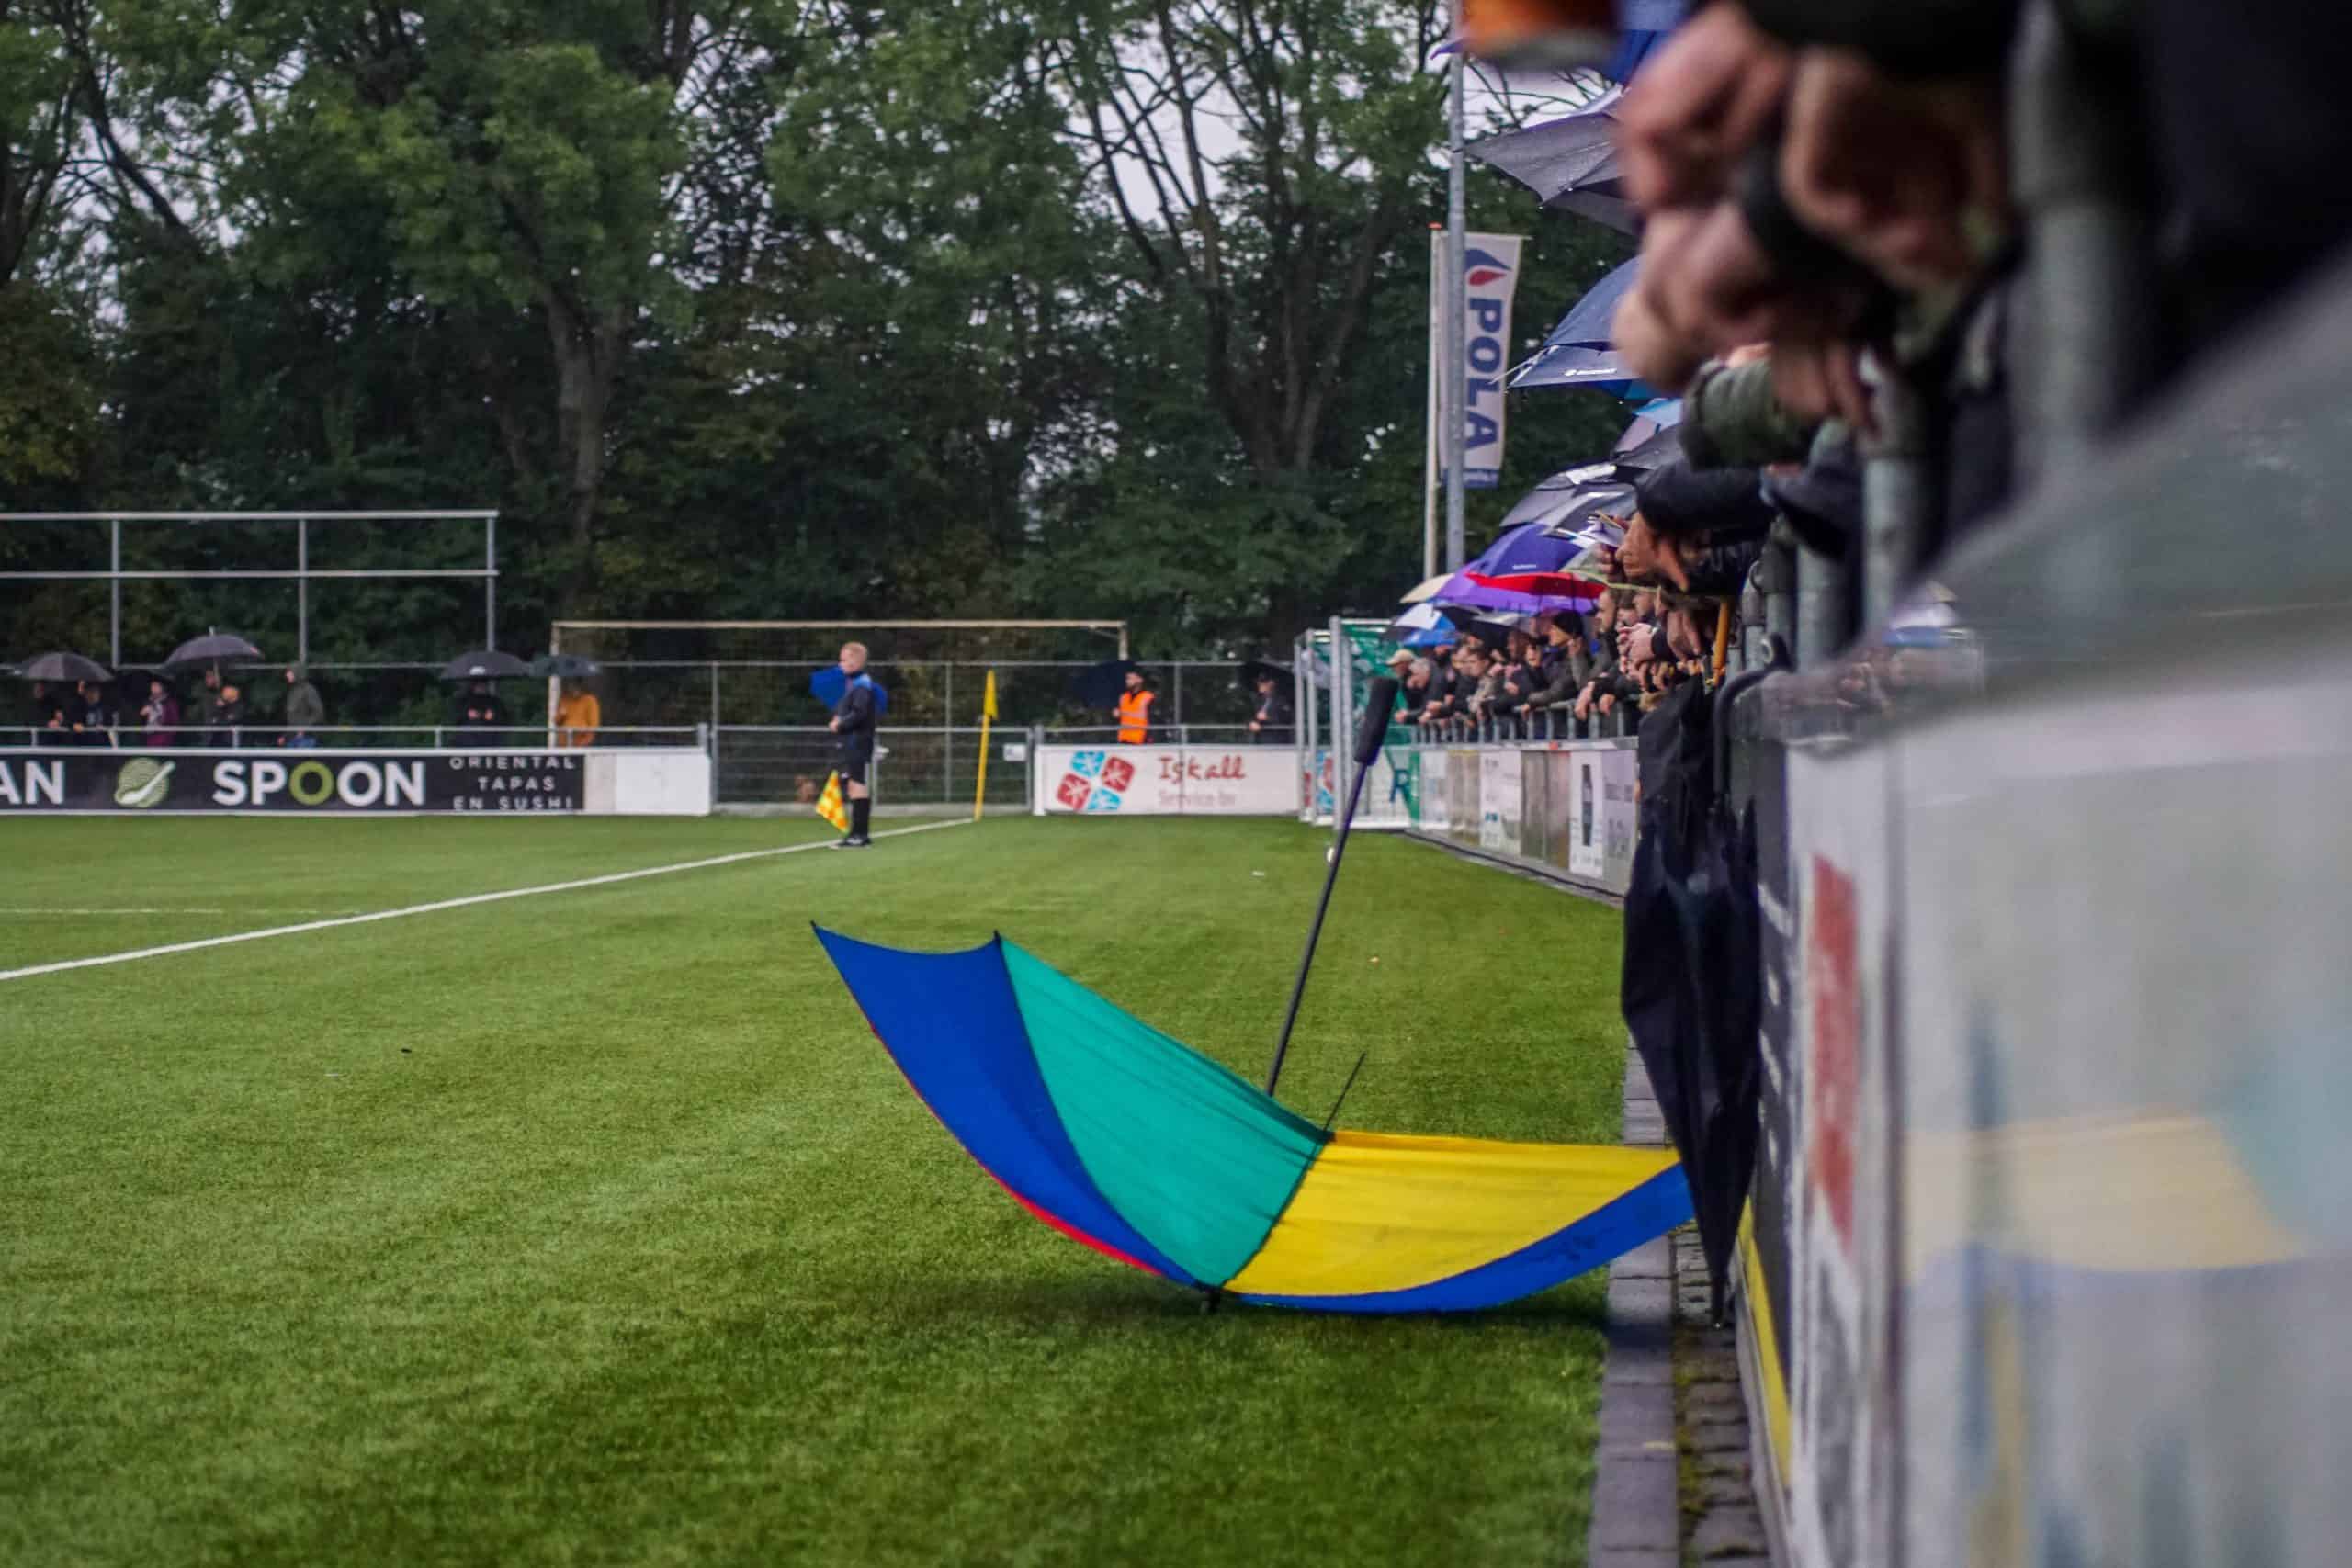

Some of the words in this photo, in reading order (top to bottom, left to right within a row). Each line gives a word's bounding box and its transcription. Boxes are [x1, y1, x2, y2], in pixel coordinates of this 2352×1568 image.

[1465, 298, 1502, 449] POLA
[449, 756, 574, 770] ORIENTAL
[212, 761, 425, 806] SPOON
[478, 777, 555, 791] TAPAS
[453, 796, 483, 810] EN
[499, 795, 573, 811] SUSHI
